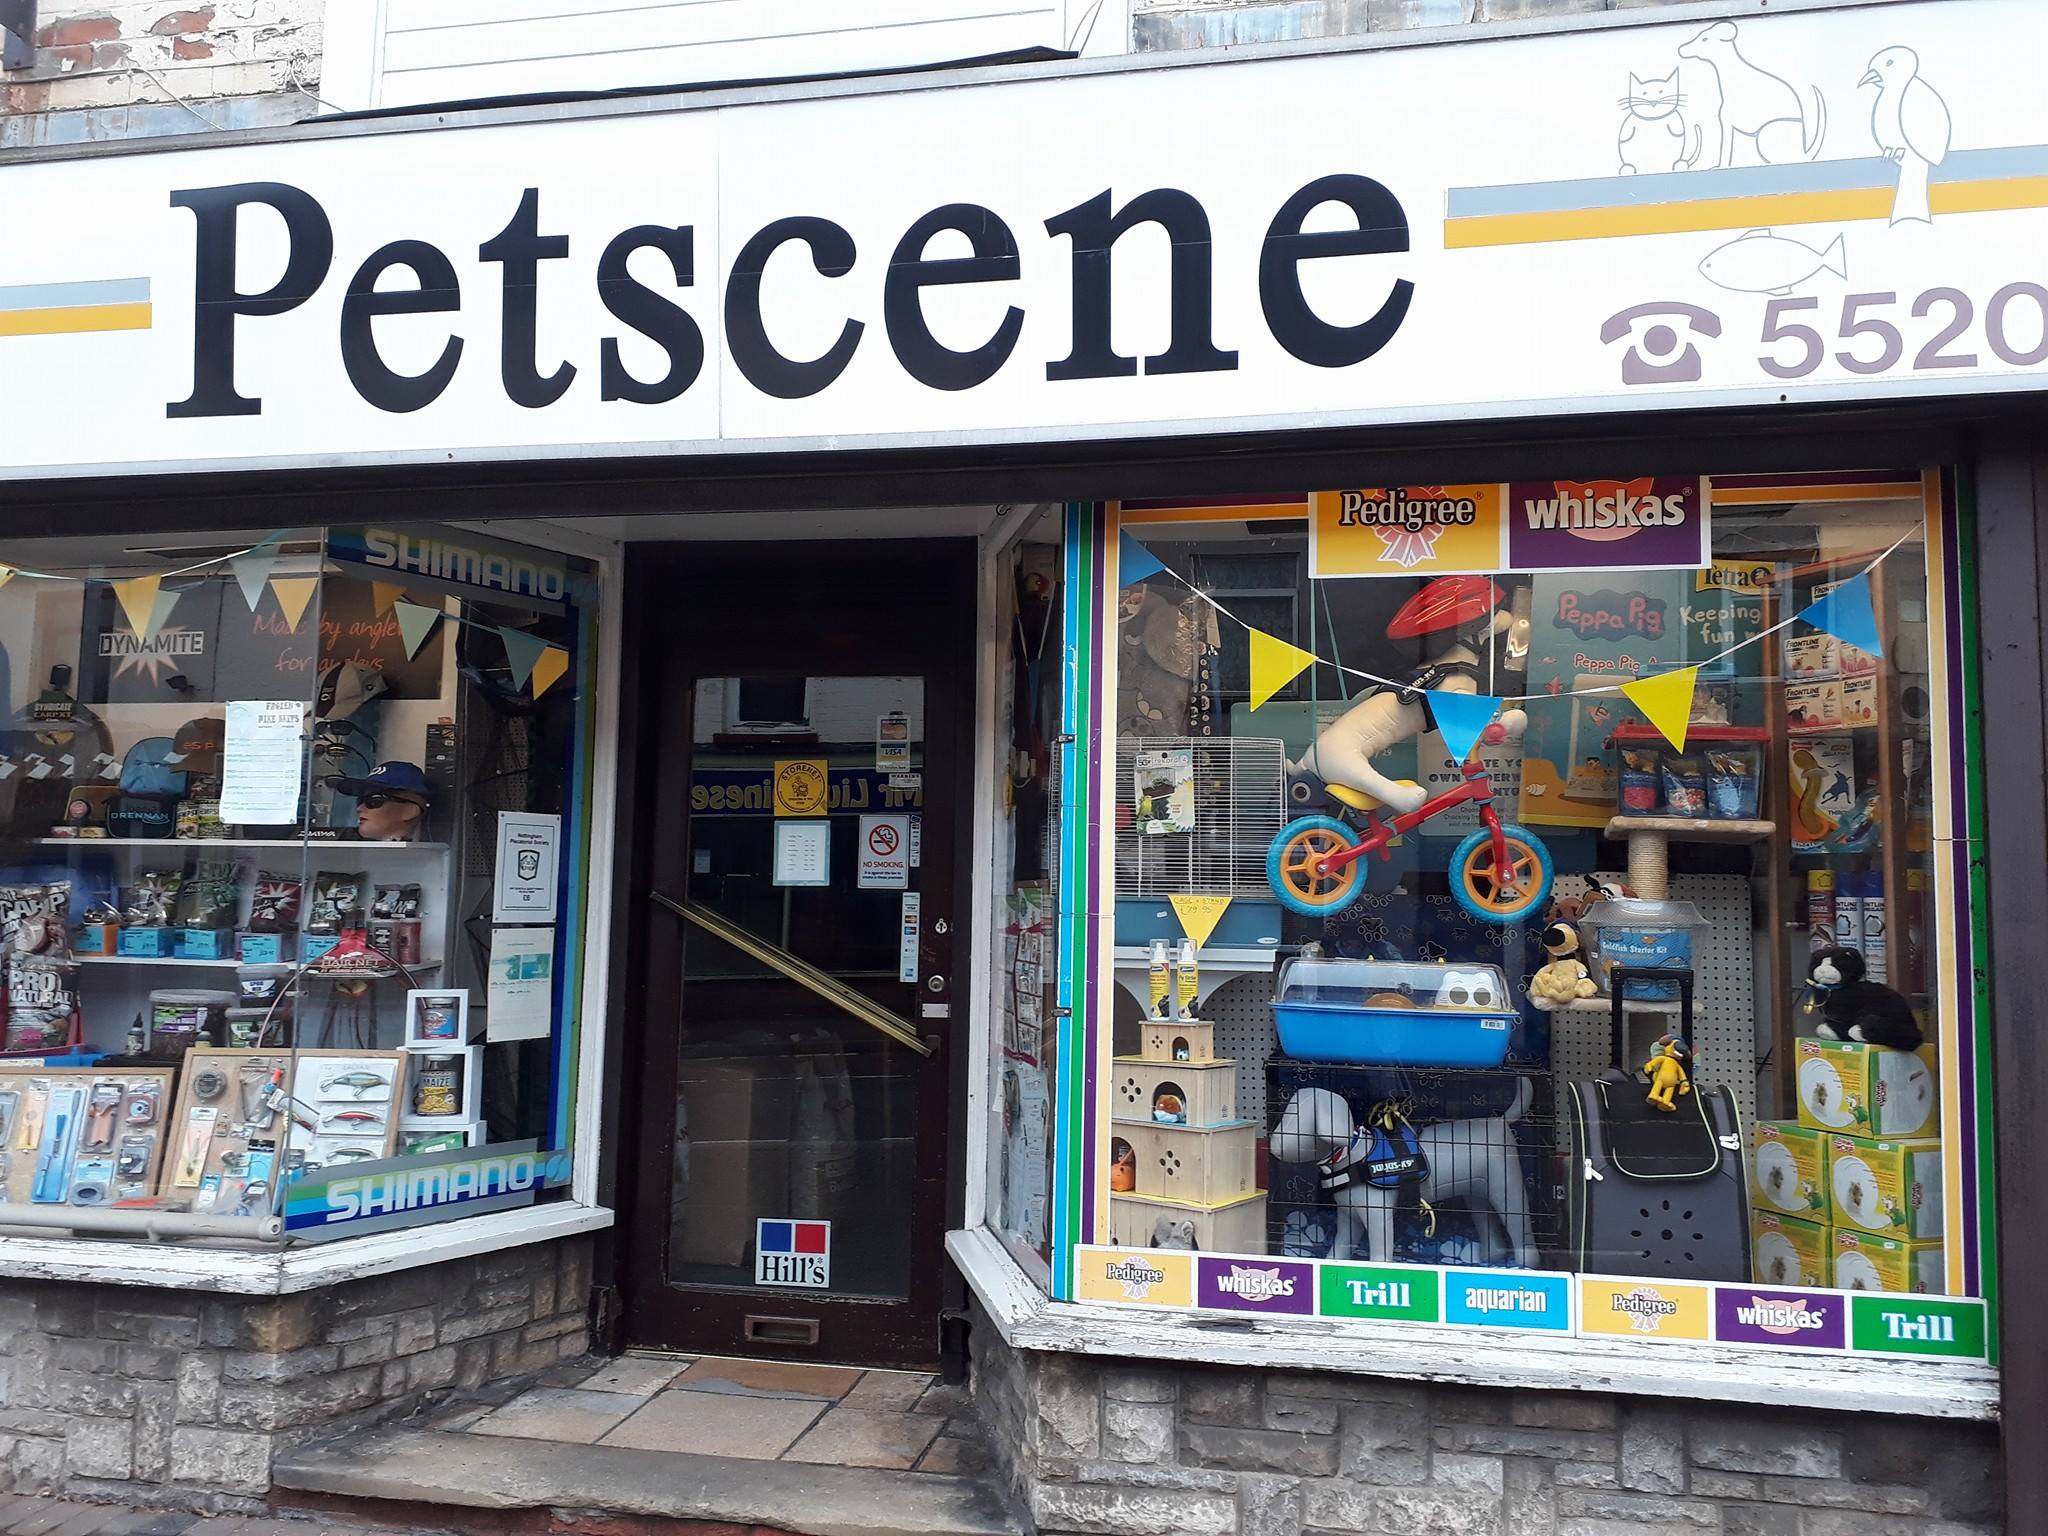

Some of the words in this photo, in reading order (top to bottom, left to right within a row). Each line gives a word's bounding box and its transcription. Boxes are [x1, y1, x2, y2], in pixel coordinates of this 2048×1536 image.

[166, 174, 1416, 418] Petscene
[1758, 281, 2048, 379] 5520
[1340, 488, 1476, 533] Pedigree
[1526, 488, 1685, 530] whiskas
[364, 529, 566, 601] SHIMANO
[320, 611, 341, 639] by
[1559, 594, 1625, 632] Peppa
[1629, 597, 1664, 633] Pig
[1680, 603, 1762, 625] Keeping
[101, 633, 203, 655] DYNAMITE
[1701, 624, 1736, 645] fun
[1786, 638, 1820, 649] FRONTLINE
[275, 647, 313, 672] for
[1574, 653, 1614, 673] Peppa
[1619, 655, 1641, 673] Pig
[1786, 687, 1820, 698] FRONTLINE
[1428, 773, 1461, 783] OWN
[111, 812, 169, 820] DRENNAN
[1602, 942, 1628, 952] Goldfish
[1630, 946, 1654, 954] Starter
[1656, 946, 1668, 954] Kit
[352, 958, 380, 967] NET
[8, 969, 61, 991] PRO
[8, 988, 73, 1007] NATURAL
[423, 1077, 450, 1087] MAIZE
[326, 1156, 538, 1225] SHIMANO
[760, 1255, 825, 1285] Hill's
[1106, 1263, 1164, 1285] Pedigree
[1217, 1271, 1295, 1297] whiskas
[1346, 1279, 1411, 1308] Trill
[1465, 1286, 1548, 1313] aquarian
[1612, 1293, 1677, 1316] Pedigree
[1737, 1303, 1824, 1330] whiskas
[1882, 1312, 1954, 1342] Trill
